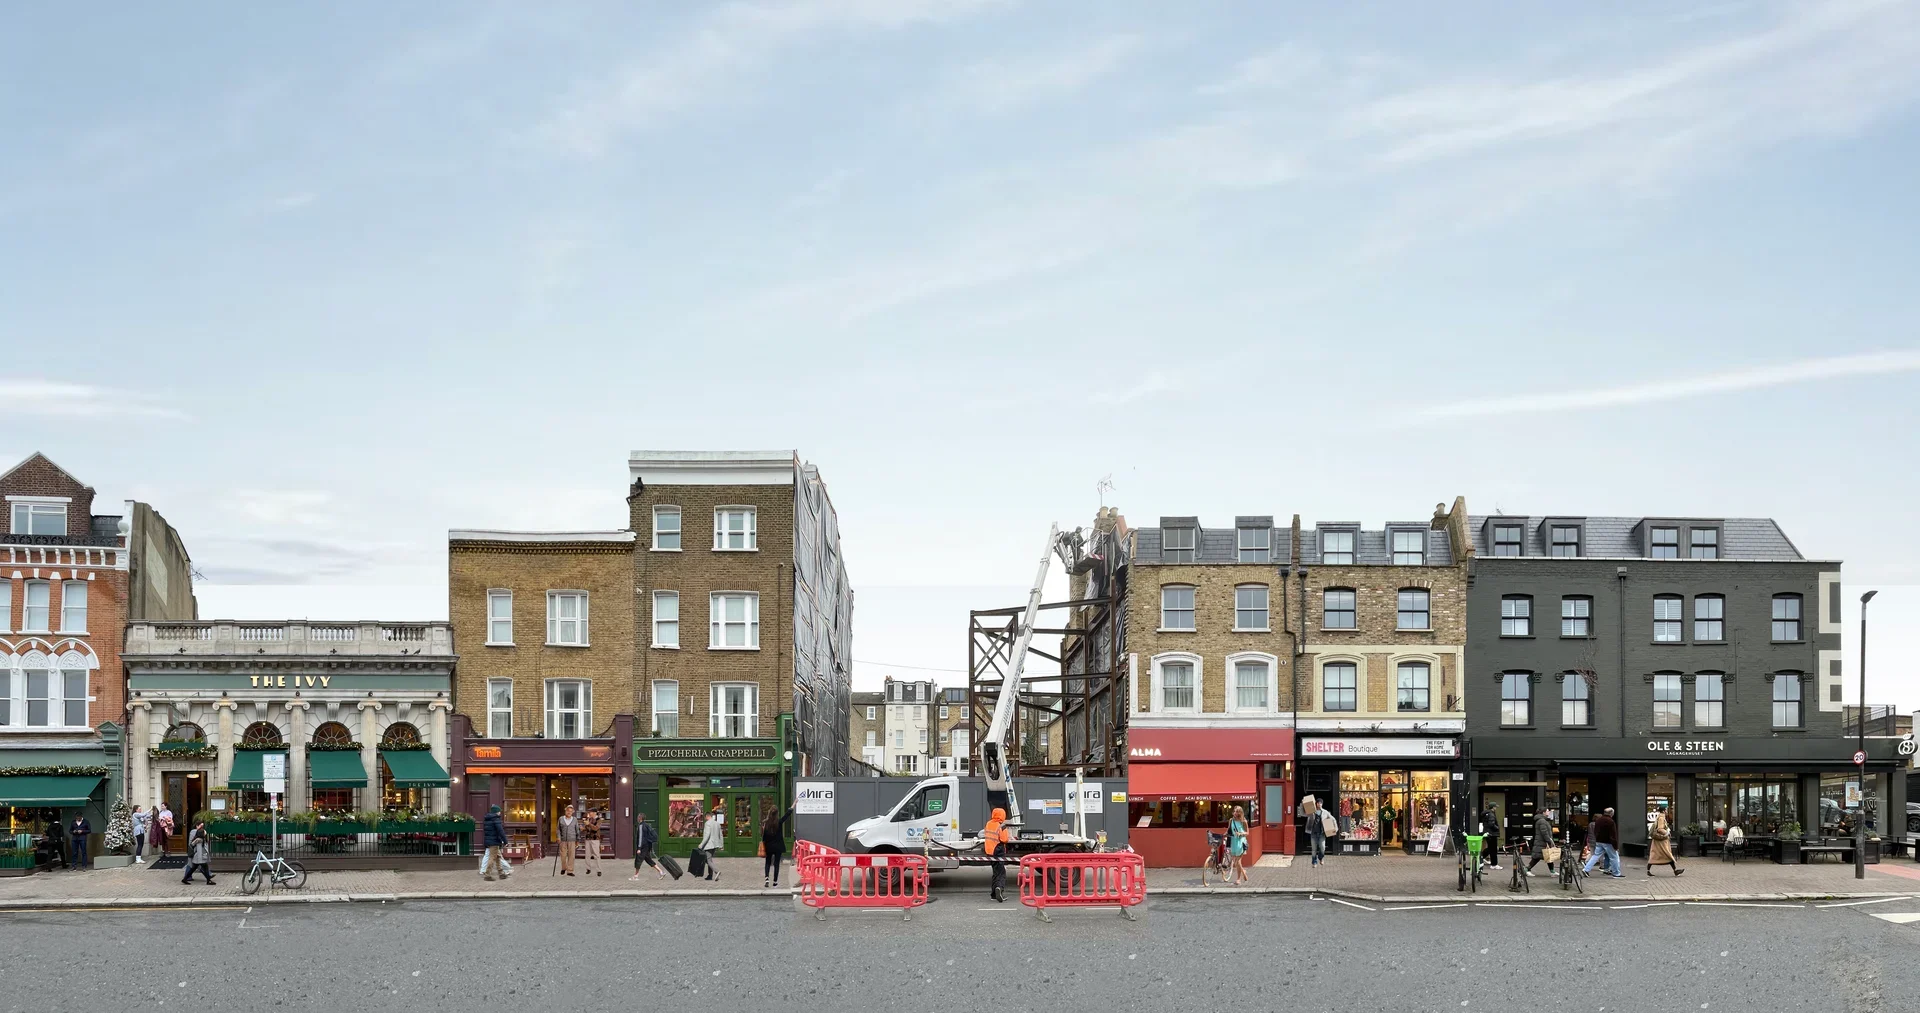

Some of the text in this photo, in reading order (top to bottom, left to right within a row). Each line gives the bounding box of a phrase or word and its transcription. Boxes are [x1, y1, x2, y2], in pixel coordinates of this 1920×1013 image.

[250, 675, 331, 687] THE IVY
[1306, 742, 1378, 753] SHELTER Boutique
[1647, 741, 1724, 751] OLE & STEEN
[474, 748, 501, 758] Tamila
[710, 749, 766, 758] GRAPPELLI
[1130, 748, 1162, 756] ALMA
[807, 789, 834, 799] hira
